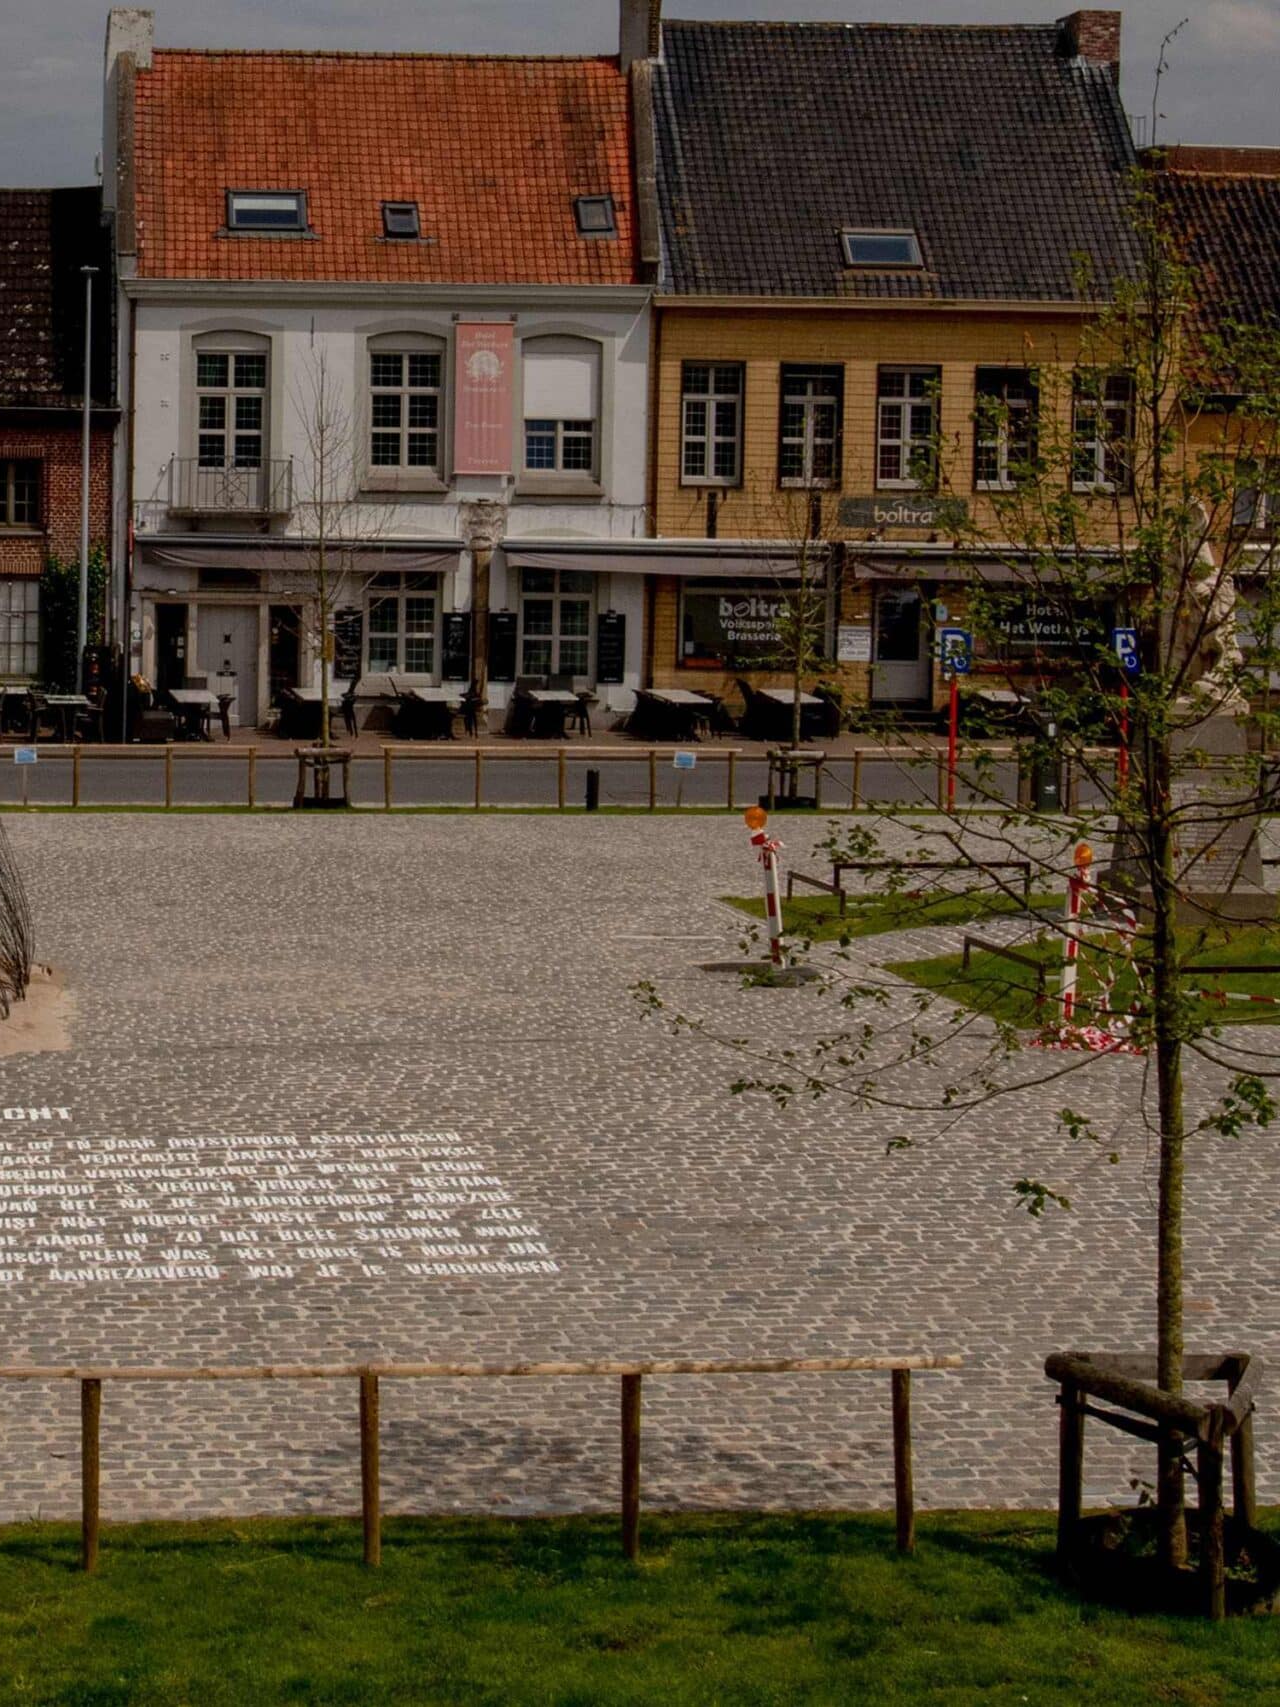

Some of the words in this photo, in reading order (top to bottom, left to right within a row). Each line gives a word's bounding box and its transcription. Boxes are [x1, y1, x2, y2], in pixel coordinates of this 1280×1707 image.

[874, 505, 933, 524] boltra
[728, 631, 782, 641] Brasserie
[28, 1141, 53, 1150] OP
[67, 1140, 91, 1150] EN
[104, 1139, 157, 1150] DAAR
[168, 1136, 299, 1148] ONTSTONDEN
[79, 1152, 197, 1164] VERPLAATST
[227, 1150, 334, 1161] DAGELIJKS
[114, 1182, 138, 1194] IS
[255, 1179, 335, 1191] VERDER
[352, 1178, 390, 1189] HET
[410, 1176, 503, 1187] BESTAAN
[60, 1200, 96, 1210] HET
[120, 1198, 151, 1208] NA
[170, 1198, 196, 1208] DE
[217, 1193, 394, 1206] VERANDERINGEN
[412, 1191, 514, 1203] AFWEZIGE
[61, 1216, 107, 1228] NIET
[131, 1214, 218, 1227] HOEVEEL
[337, 1210, 387, 1222] DAN
[406, 1209, 451, 1221] WAT
[481, 1207, 523, 1220] ZELF
[36, 1233, 105, 1245] AARDE
[123, 1232, 149, 1244] IN
[175, 1231, 204, 1243] ZO
[220, 1230, 262, 1242] DAT
[278, 1229, 338, 1241] BLEEF
[356, 1227, 462, 1240] STROMEN
[474, 1225, 541, 1237] WAAR
[79, 1250, 143, 1262] PLEIN
[159, 1249, 211, 1261] WAS
[235, 1248, 275, 1260] HET
[296, 1247, 360, 1259] EINDE
[378, 1246, 404, 1257] IS
[420, 1244, 491, 1257] NOOIT
[507, 1242, 551, 1254] DAT
[48, 1264, 221, 1281] AANGEZUIVERD
[247, 1264, 297, 1279] WAT
[316, 1264, 344, 1277] JE
[361, 1264, 387, 1276] IS
